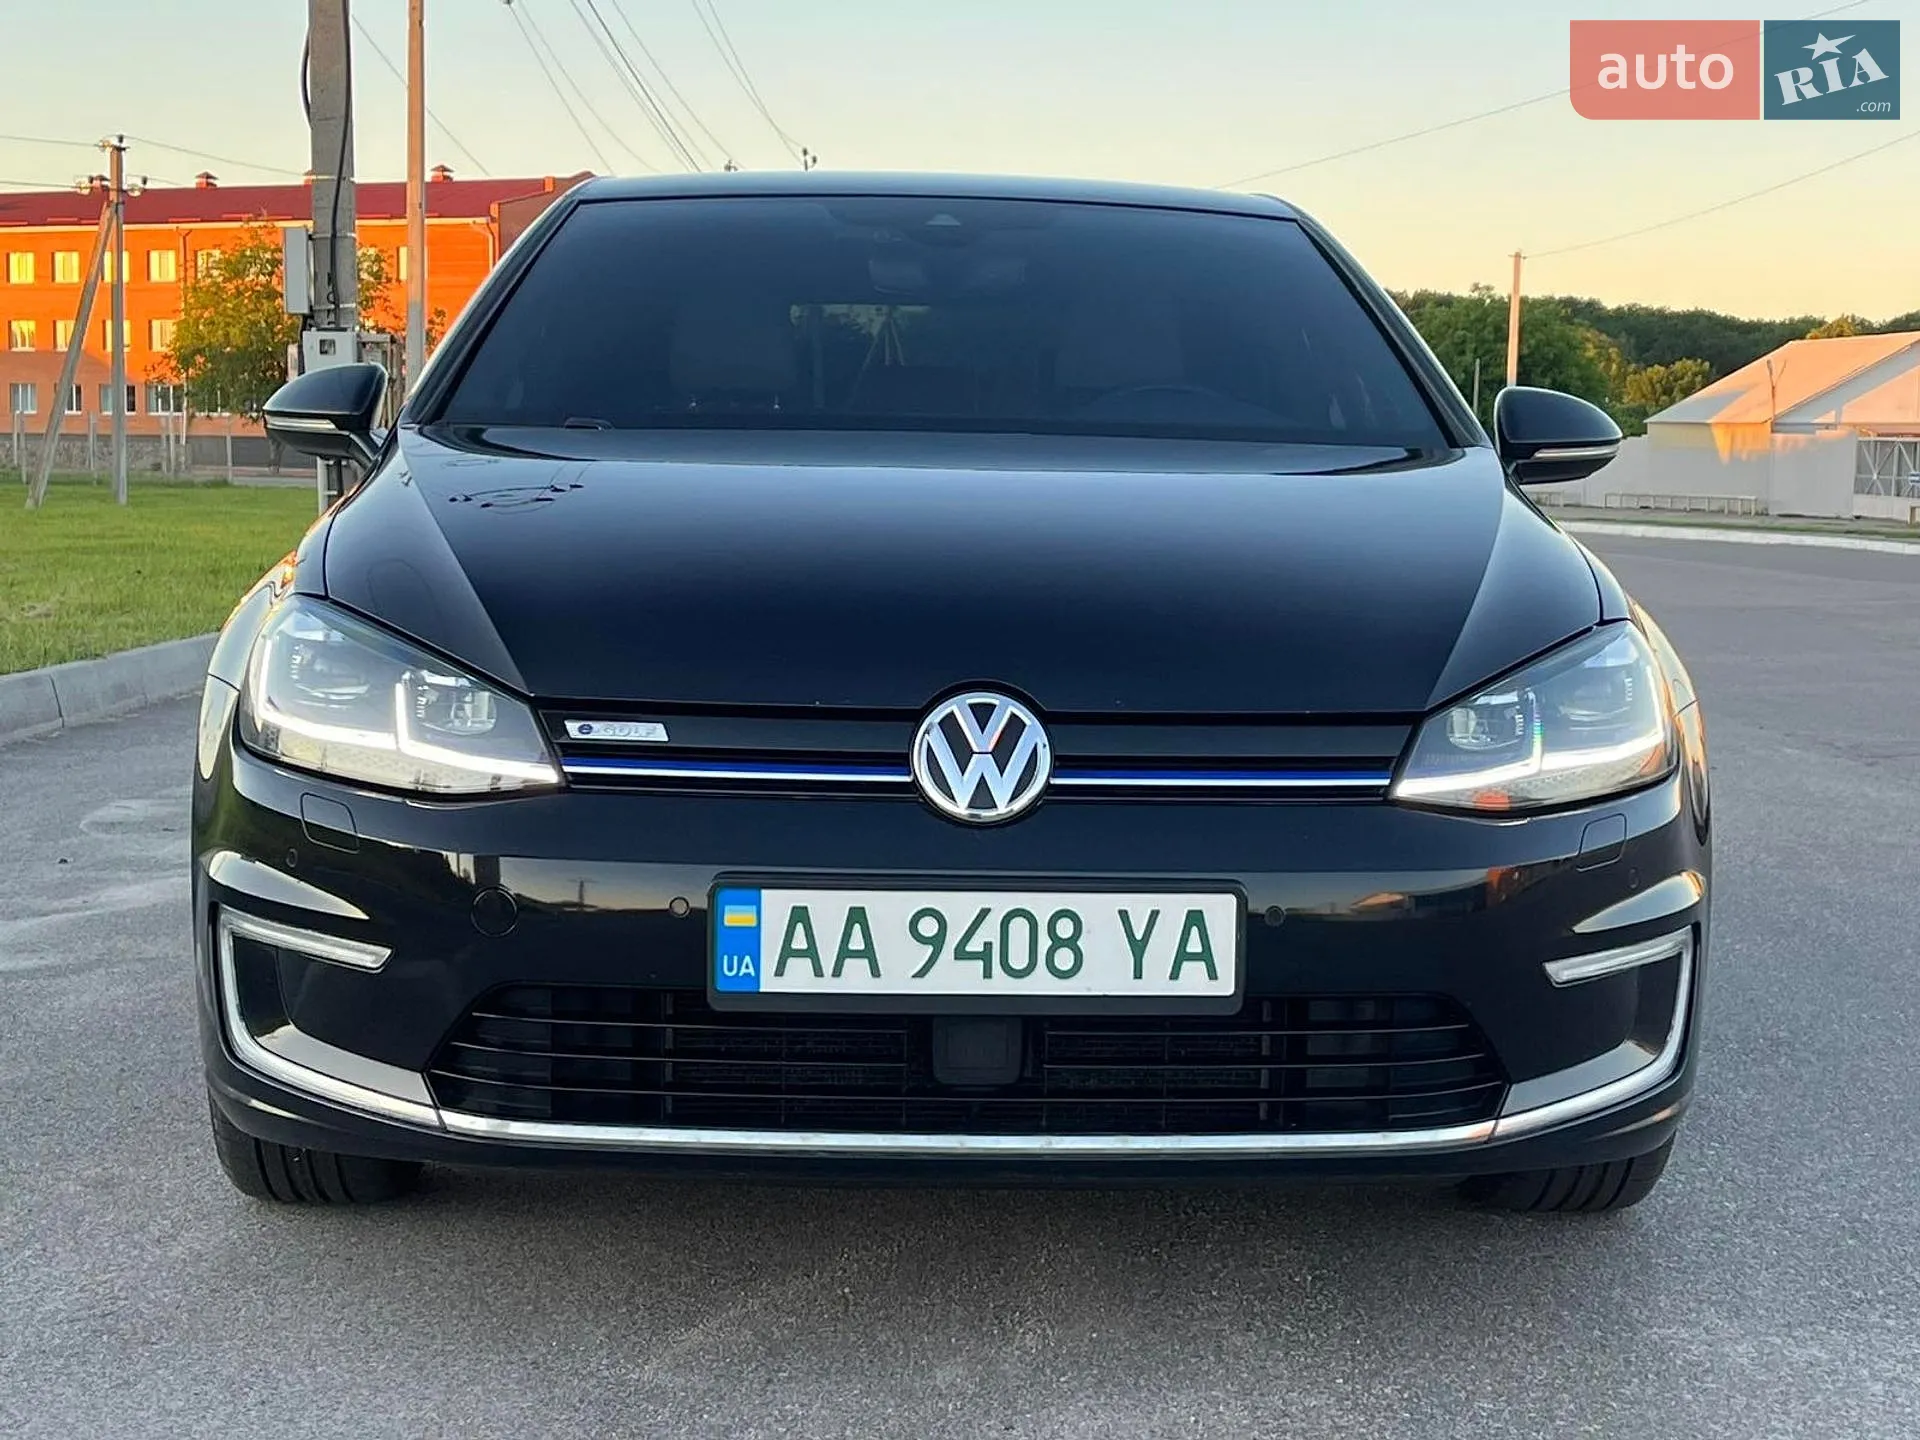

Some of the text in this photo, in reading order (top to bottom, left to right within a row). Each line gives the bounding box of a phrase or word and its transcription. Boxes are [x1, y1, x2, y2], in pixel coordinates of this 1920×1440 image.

[722, 954, 756, 977] UA
[773, 905, 1219, 981] AA 9408 YA
